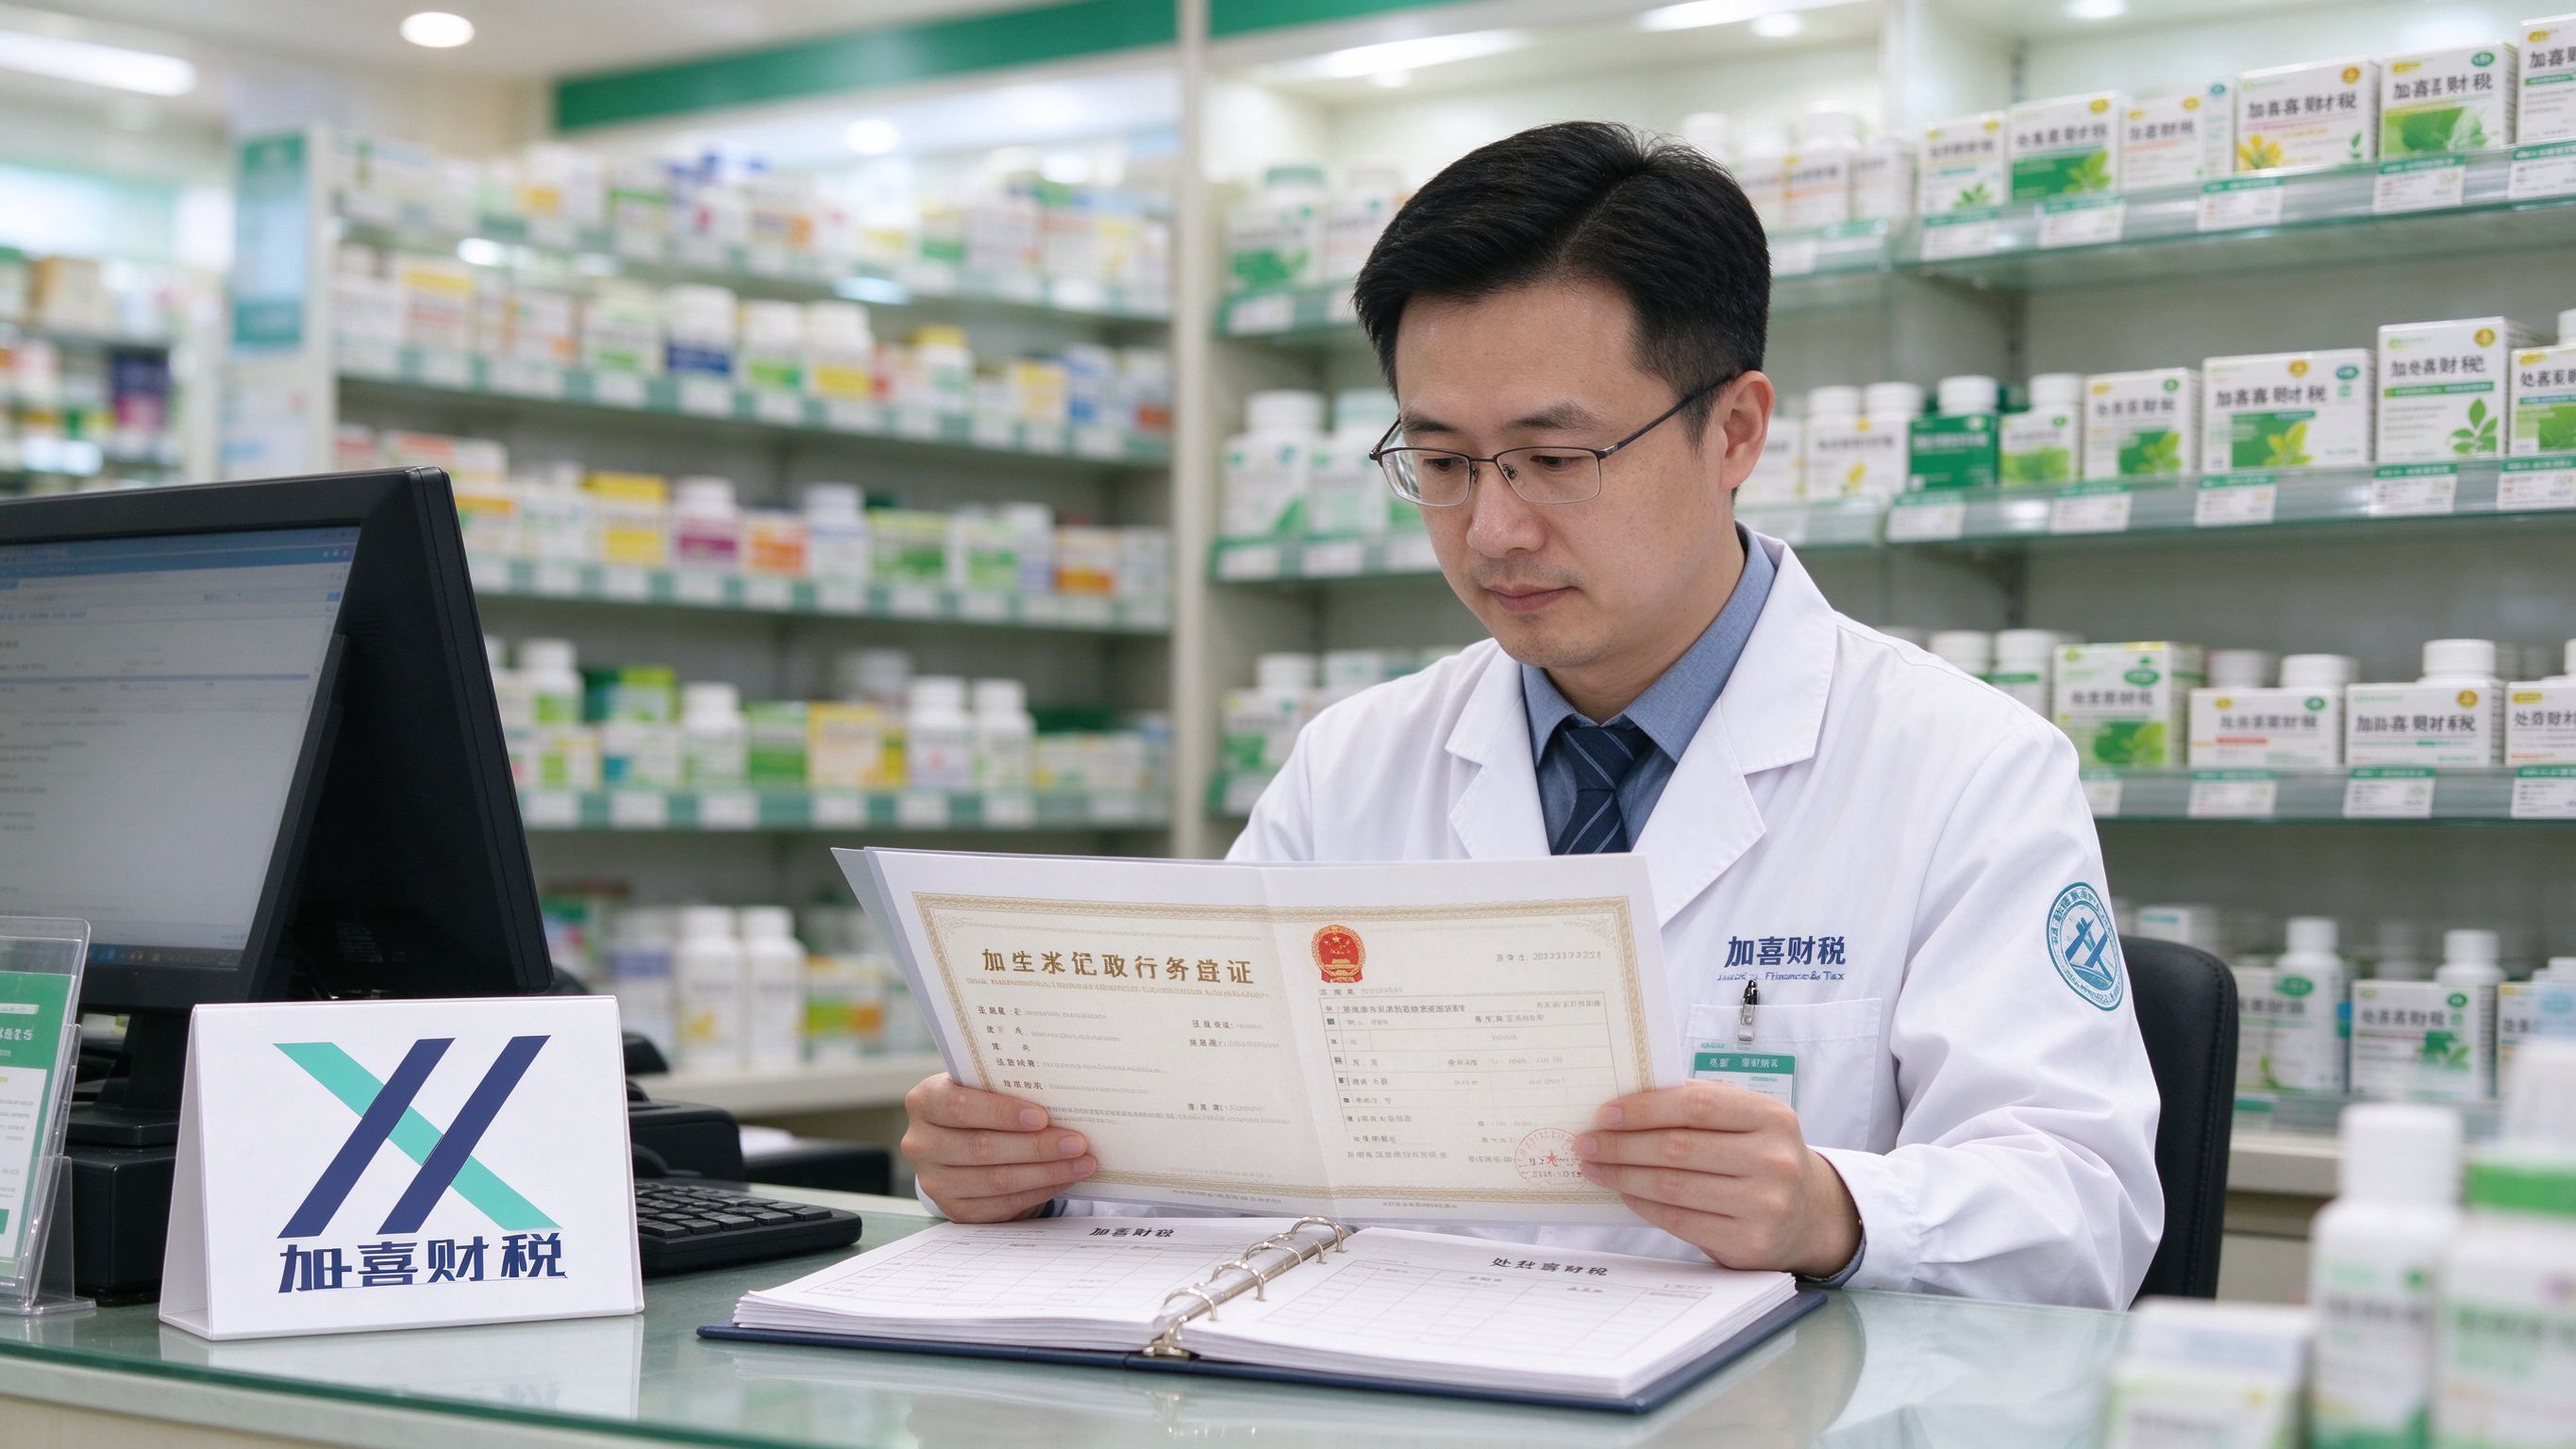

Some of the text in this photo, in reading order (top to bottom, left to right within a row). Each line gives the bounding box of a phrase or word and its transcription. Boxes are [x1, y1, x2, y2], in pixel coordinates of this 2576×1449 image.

[1724, 936, 1847, 968] 加喜财税
[277, 1232, 568, 1294] 加喜财税
